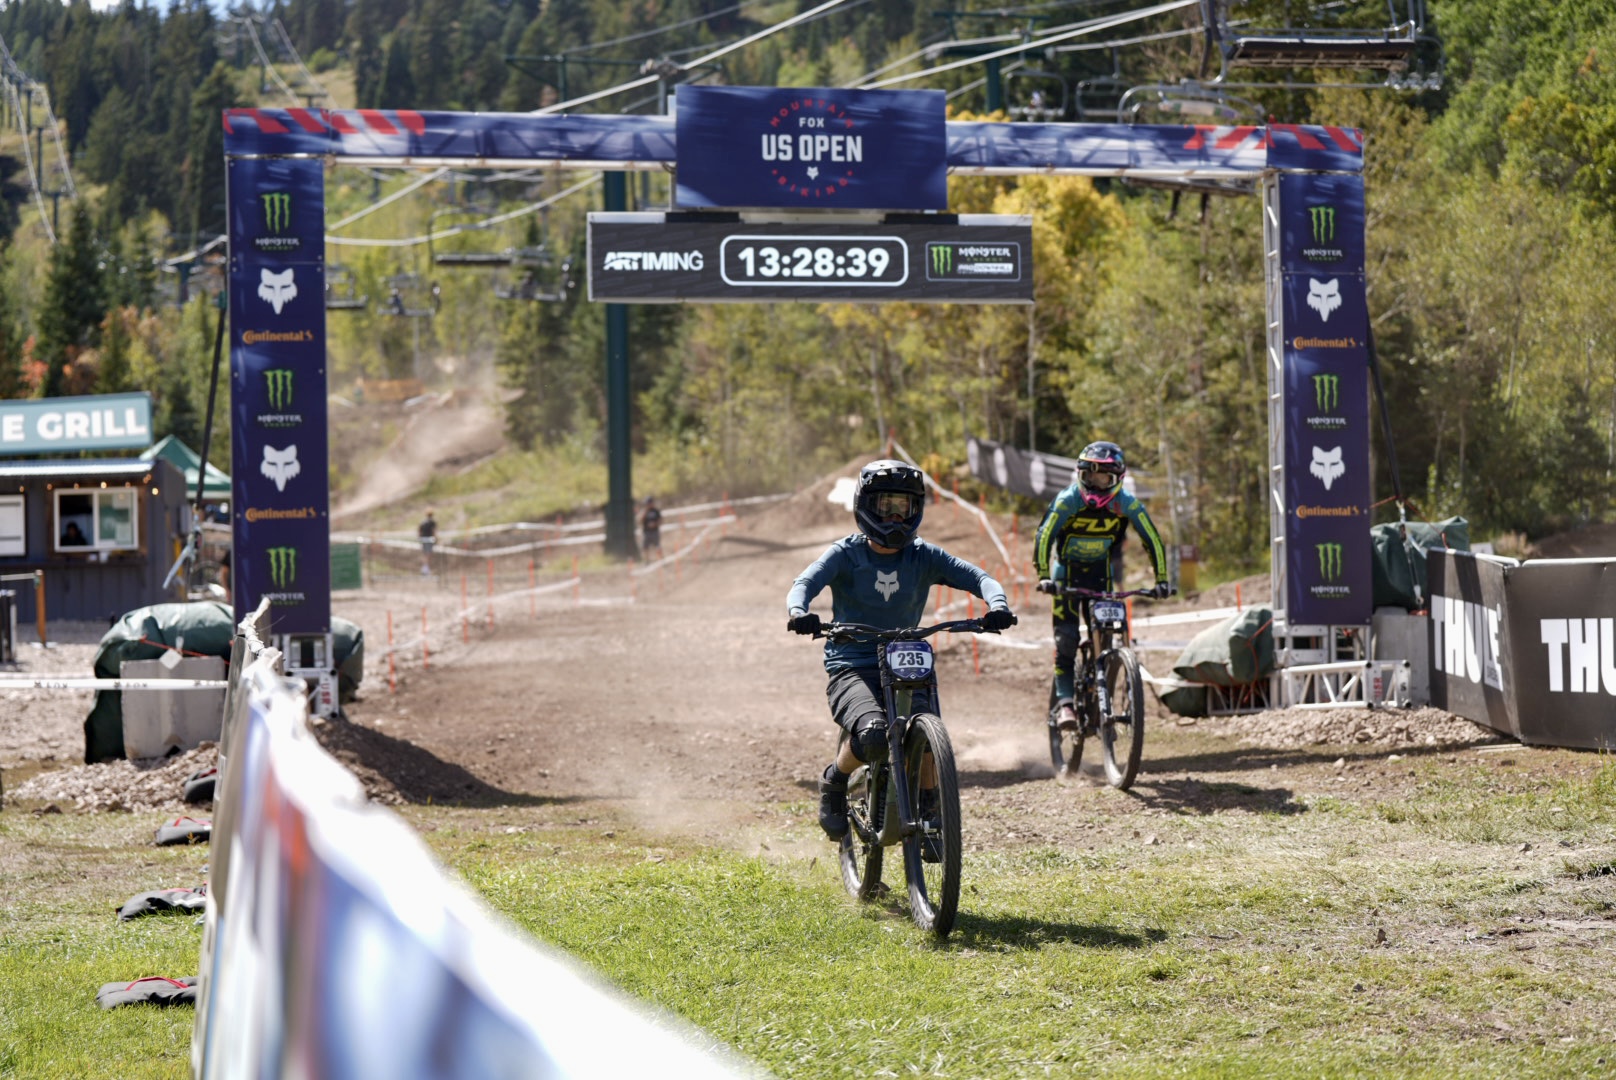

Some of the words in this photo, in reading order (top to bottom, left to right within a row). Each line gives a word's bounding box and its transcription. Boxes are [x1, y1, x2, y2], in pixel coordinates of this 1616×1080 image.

[799, 117, 825, 128] FOX
[762, 134, 793, 161] US
[799, 134, 862, 162] OPEN
[255, 237, 300, 247] MONSTER
[958, 246, 1012, 257] MONSTER
[1303, 248, 1343, 258] MONSTER
[738, 247, 890, 277] 13:28:39
[242, 330, 304, 344] Continental
[1293, 336, 1348, 350] Continental
[2, 414, 25, 441] E
[36, 407, 148, 440] GRILL
[1307, 417, 1346, 426] MONSTER
[245, 507, 307, 522] Continental
[1296, 505, 1351, 519] Continental
[1072, 518, 1119, 532] FLY
[1431, 594, 1504, 692] THULE
[898, 652, 924, 666] 235
